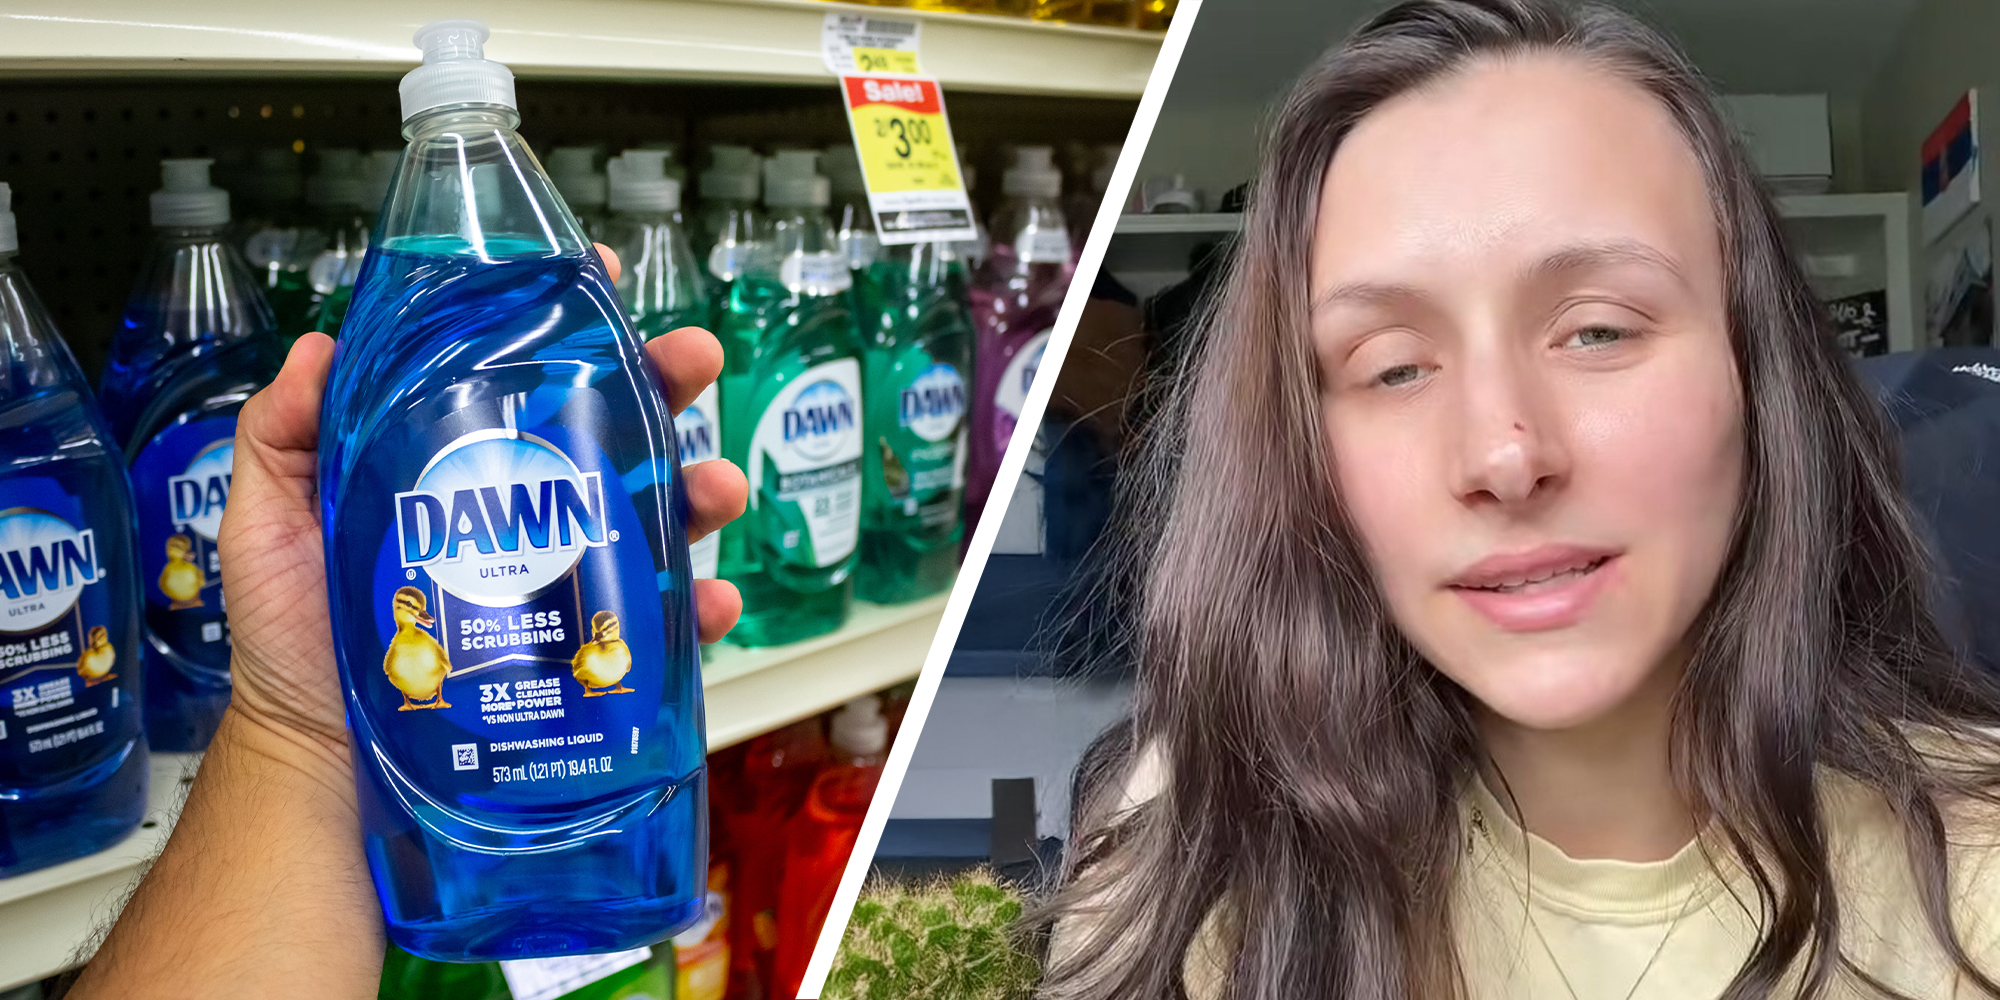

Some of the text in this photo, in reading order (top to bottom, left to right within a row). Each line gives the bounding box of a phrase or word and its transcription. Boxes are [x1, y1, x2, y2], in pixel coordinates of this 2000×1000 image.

[862, 80, 925, 103] Sale!
[900, 385, 964, 422] DAWN
[783, 403, 853, 442] DAWN
[676, 425, 712, 461] WN
[168, 474, 232, 526] DA
[395, 472, 608, 567] DAWN
[0, 529, 98, 600] AWN
[479, 564, 530, 579] ULTRA
[8, 603, 46, 617] ULTRA
[460, 611, 562, 636] 50% LESS
[30, 631, 70, 651] LESS
[461, 629, 565, 651] SCRUBBING
[479, 677, 561, 703] 3X GREASE
[515, 688, 562, 699] CLEANING
[517, 696, 562, 710] POWER
[496, 712, 515, 724] NON
[515, 710, 540, 722] ULTRA
[540, 708, 565, 720] DAWN
[490, 733, 604, 752] DISHWASHING LIQUID
[492, 756, 613, 783] 573 mL (1.21 PT) 19.4 FL OZ
